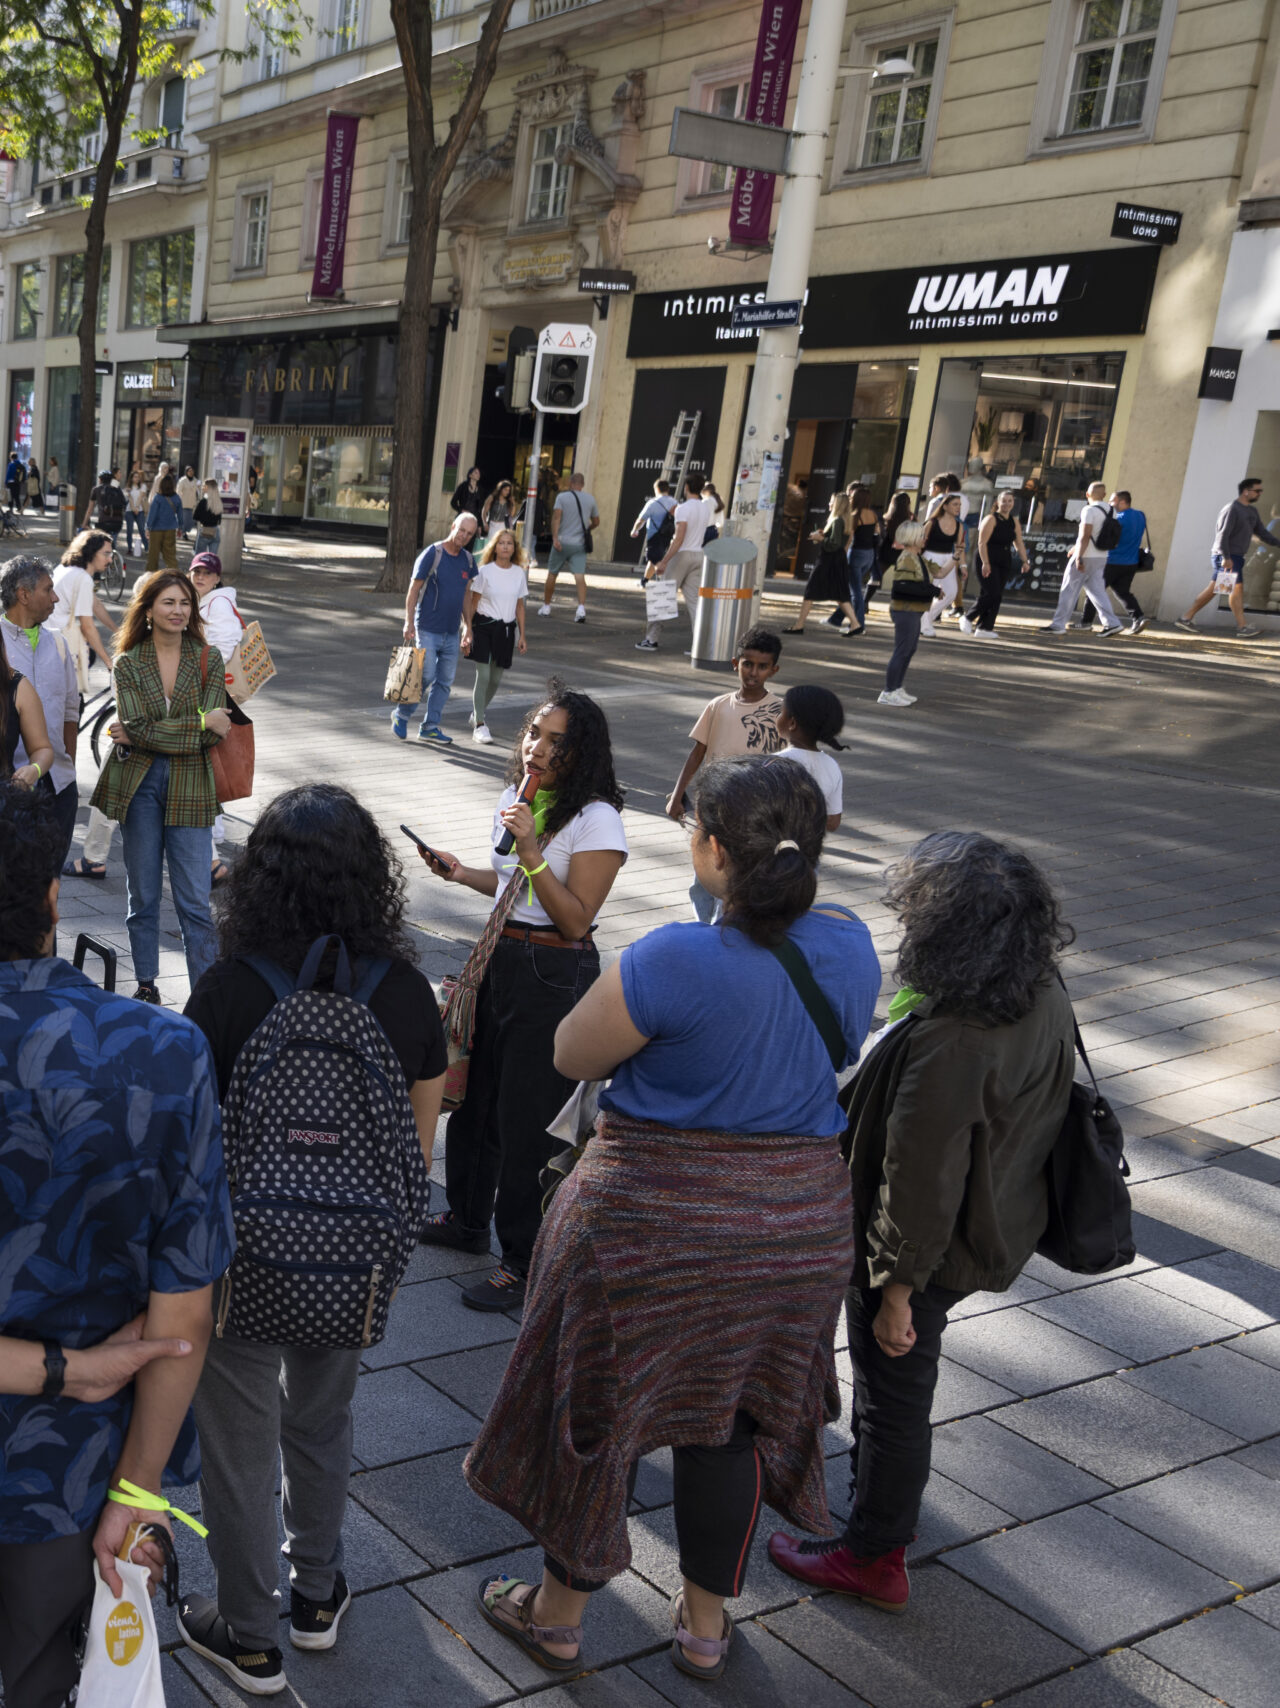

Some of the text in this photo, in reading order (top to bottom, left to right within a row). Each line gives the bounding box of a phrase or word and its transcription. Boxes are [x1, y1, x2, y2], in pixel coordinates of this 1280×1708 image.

[763, 6, 784, 62] Wien
[320, 174, 342, 284] Möbelmuseum
[331, 129, 345, 169] Wien
[907, 264, 1070, 314] IUMAN
[909, 310, 1059, 330] intimissimi uomo
[245, 365, 350, 392] FABRINI
[1209, 368, 1236, 379] MANGO
[287, 1129, 340, 1146] JANSPORT
[118, 1627, 141, 1640] latina
